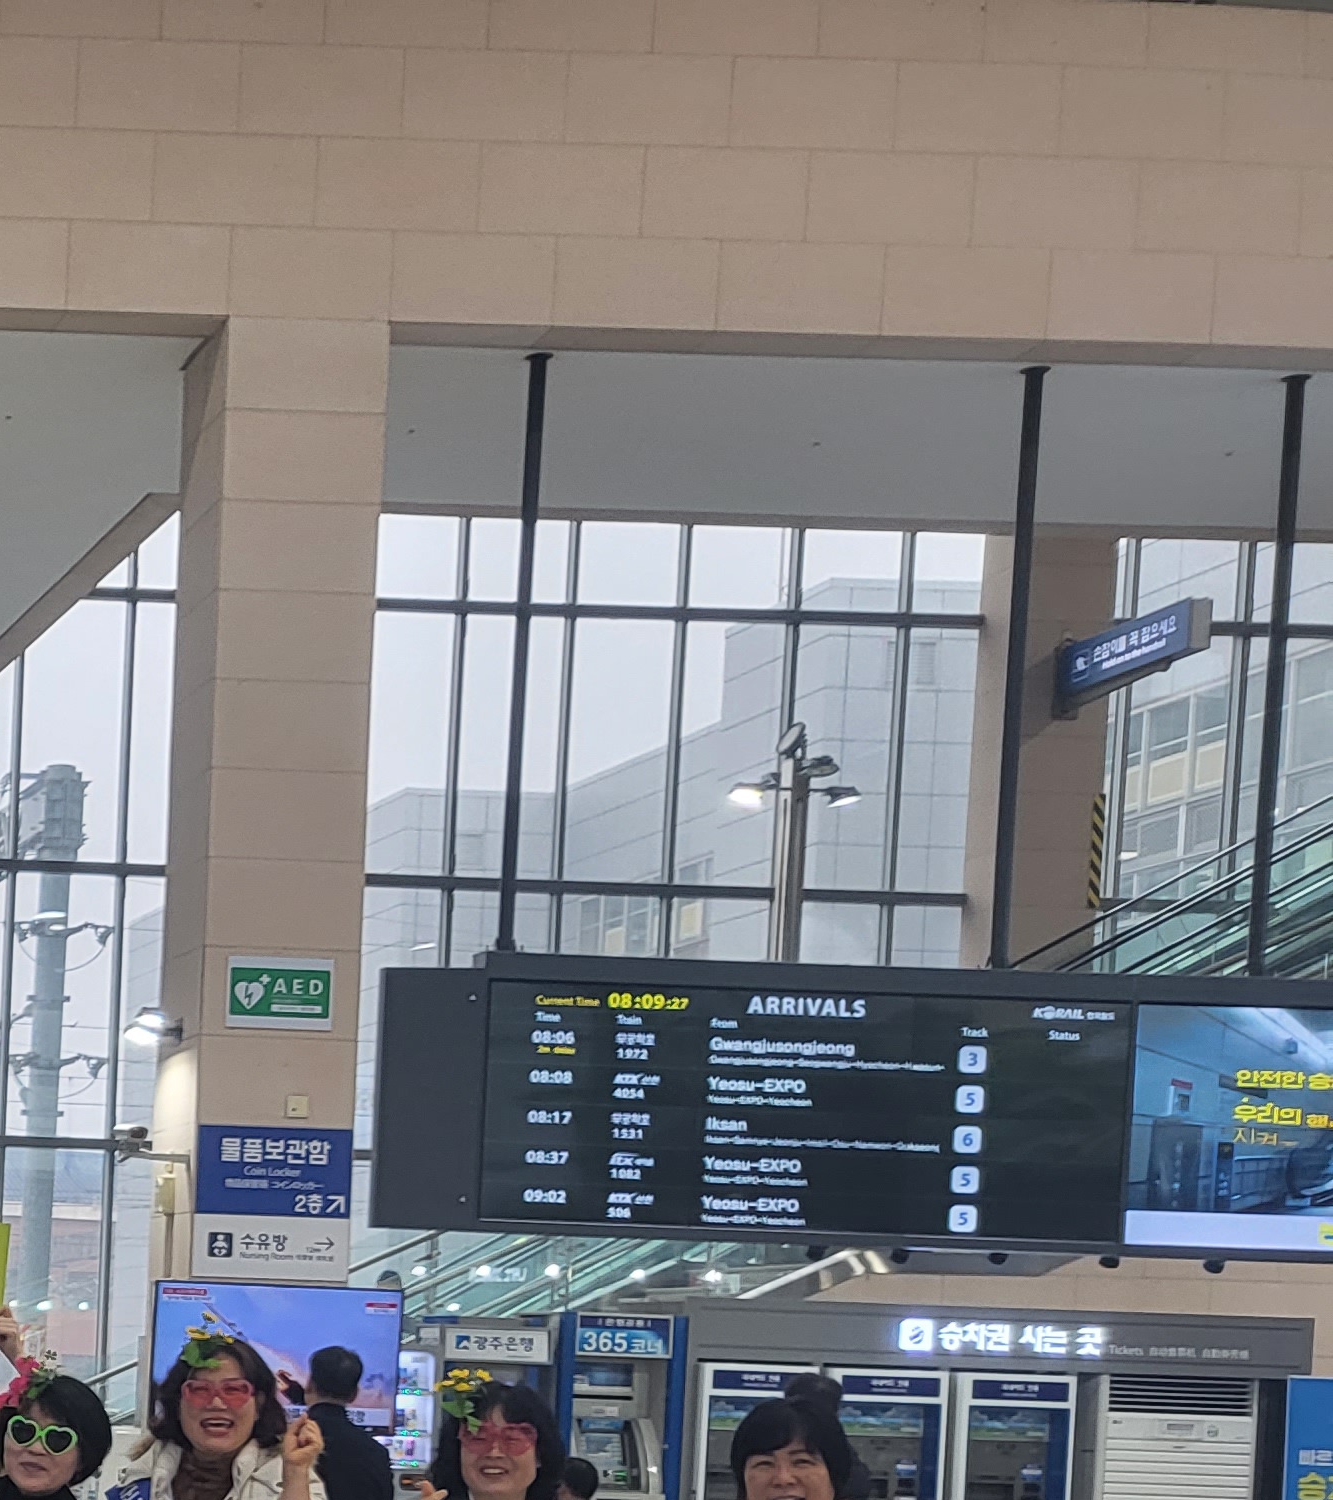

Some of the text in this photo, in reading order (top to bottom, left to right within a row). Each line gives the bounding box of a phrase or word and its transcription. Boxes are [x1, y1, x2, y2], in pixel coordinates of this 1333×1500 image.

[273, 978, 324, 995] AED
[608, 992, 689, 1010] 08:09:27
[746, 995, 866, 1019] ARRIVALS
[1032, 1006, 1084, 1020] KORAIL
[534, 1012, 561, 1022] Time
[961, 1027, 988, 1037] Track
[1048, 1030, 1080, 1041] Status
[531, 1031, 575, 1044] 08:06
[529, 1071, 573, 1084] 08:08
[707, 1077, 806, 1094] Yeosu-EXPO
[1236, 1069, 1305, 1090] 안전한
[527, 1111, 572, 1125] 08:17
[705, 1117, 748, 1131] Iksan
[1232, 1097, 1302, 1125] 우리의
[220, 1136, 332, 1166] 물품보관함
[243, 1165, 267, 1176] Coin
[525, 1151, 569, 1164] 08:37
[702, 1156, 802, 1173] Yeosu-EXPO
[294, 1193, 323, 1214] 2층
[523, 1191, 567, 1204] 09:02
[701, 1196, 800, 1212] Yeosu-EXPO
[240, 1233, 288, 1252] 수유방
[473, 1334, 534, 1351] 광주은행
[938, 1321, 1103, 1357] 승차권 사는 곳
[1109, 1344, 1144, 1357] Tickets
[1297, 1472, 1333, 1500] 승
